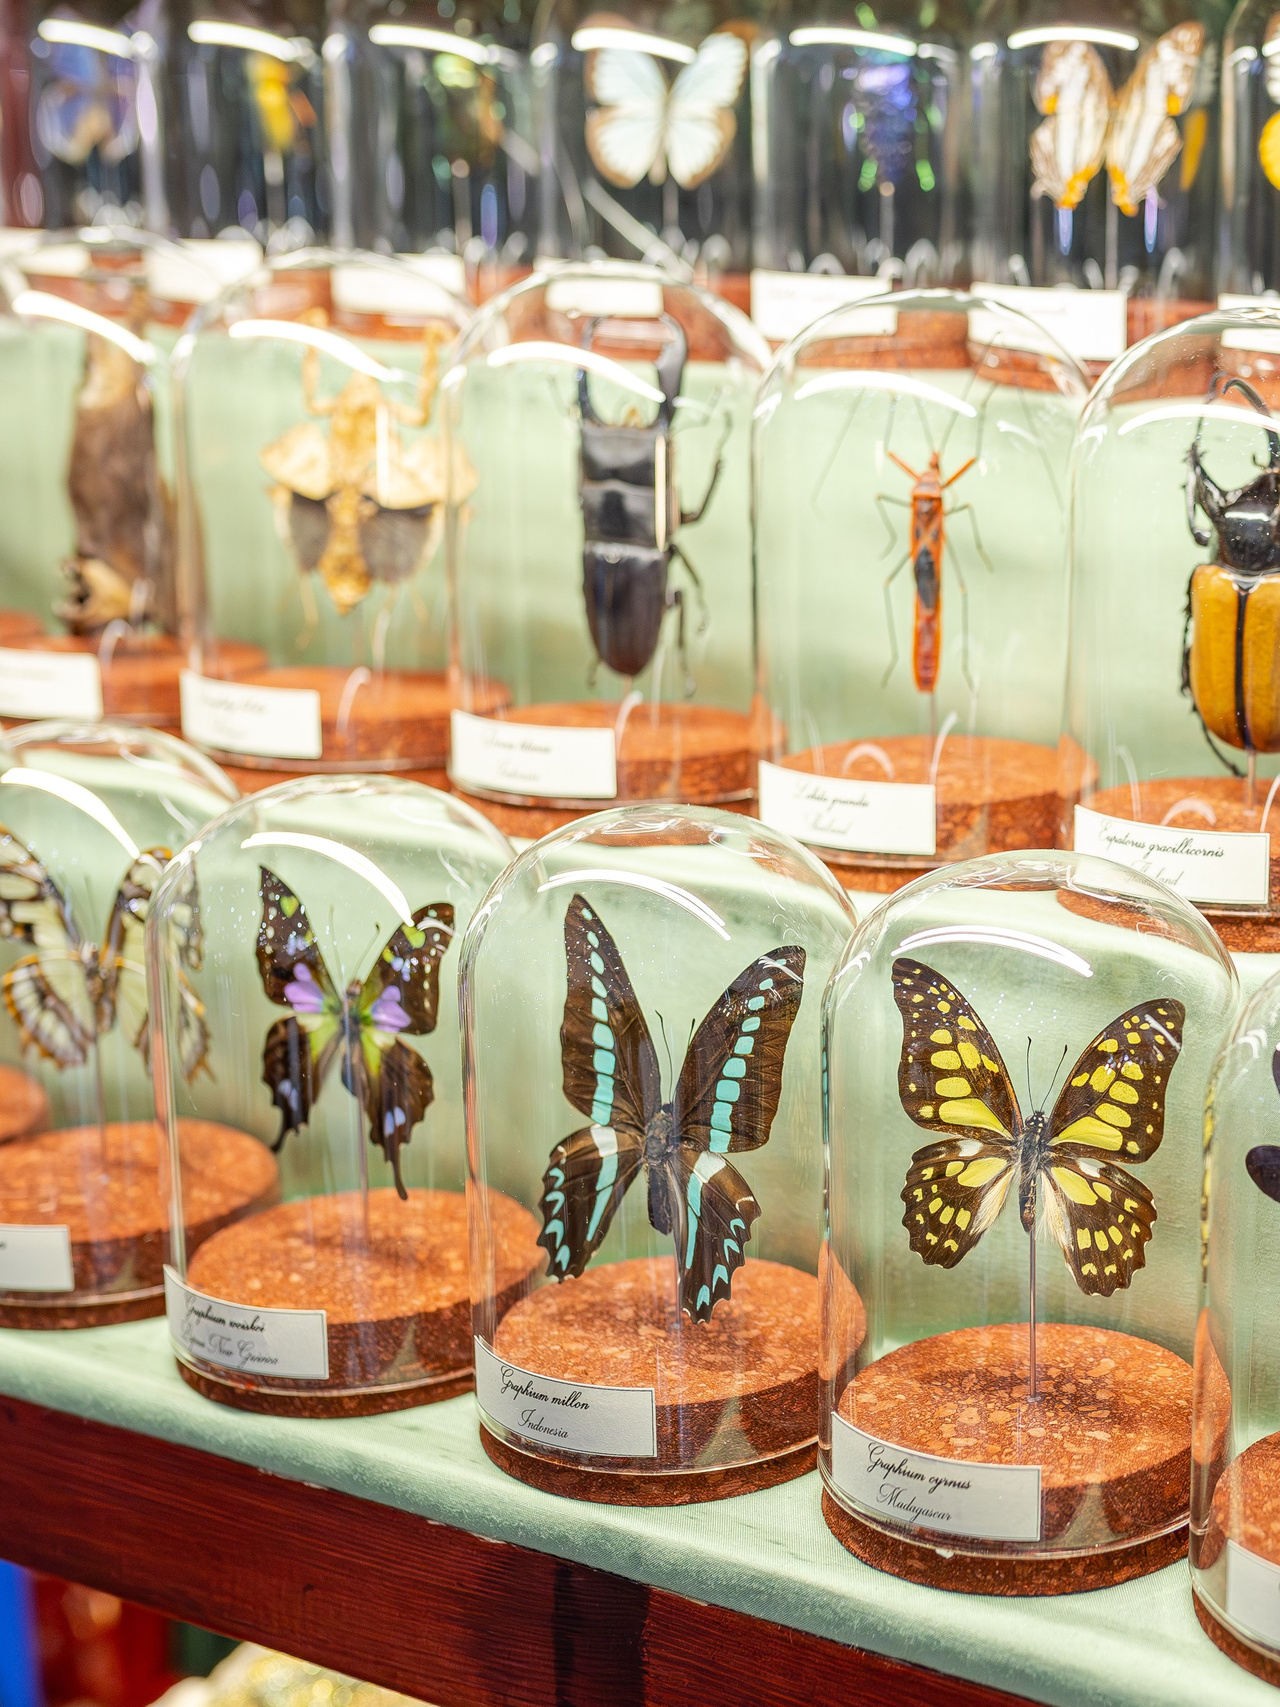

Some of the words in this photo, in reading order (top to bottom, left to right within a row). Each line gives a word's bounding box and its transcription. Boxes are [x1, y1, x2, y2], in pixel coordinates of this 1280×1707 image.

[500, 1365, 549, 1401] Graphium
[550, 1390, 590, 1410] millon
[517, 1408, 569, 1439] Indonesia
[866, 1441, 926, 1483] Graphium
[928, 1474, 972, 1495] cyrnus
[876, 1482, 953, 1524] Madagascar
